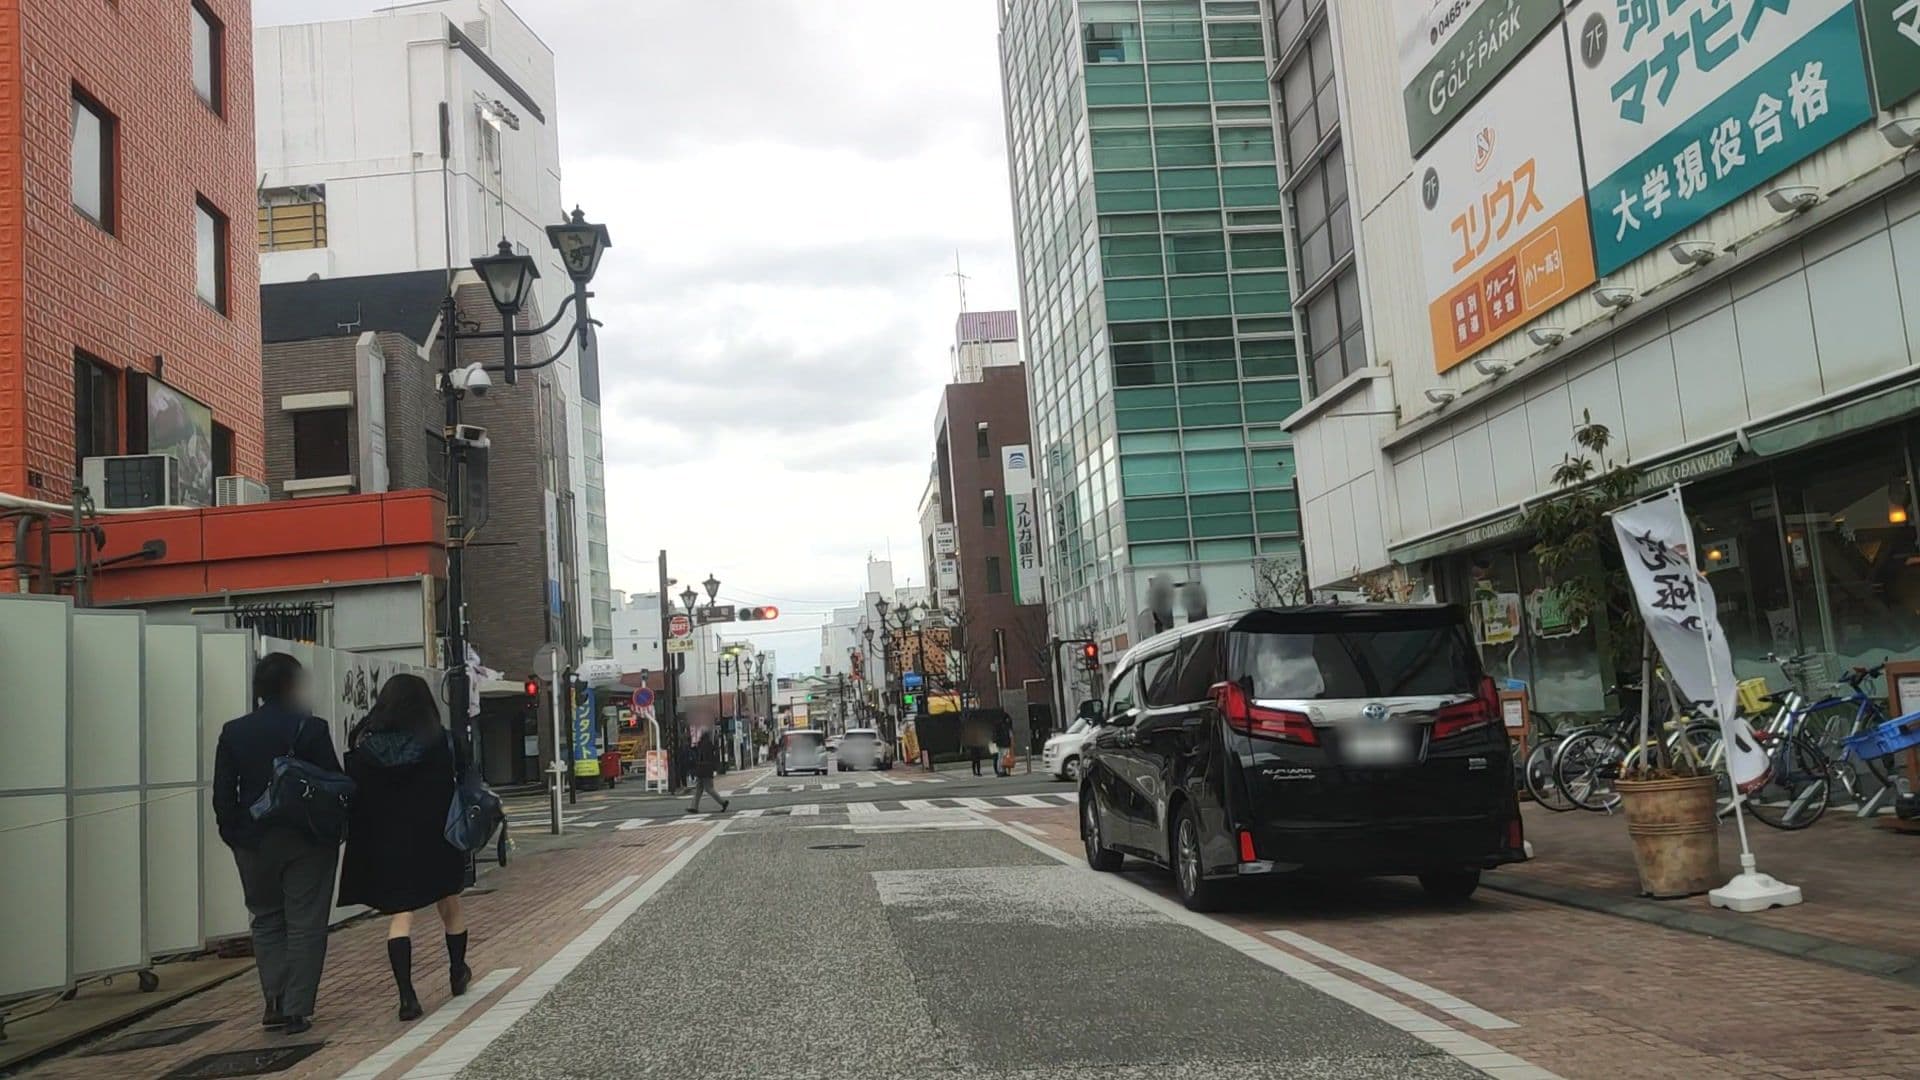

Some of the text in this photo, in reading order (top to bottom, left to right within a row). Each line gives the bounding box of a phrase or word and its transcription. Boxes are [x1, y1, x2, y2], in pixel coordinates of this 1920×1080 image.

[1428, 4, 1521, 116] GOLF PARK
[1585, 23, 1604, 58] 7F
[1612, 60, 1830, 243] 大学現役合格
[1450, 157, 1545, 274] ユリウス
[1485, 264, 1517, 301] グループ
[1017, 502, 1033, 569] スルガ銀行
